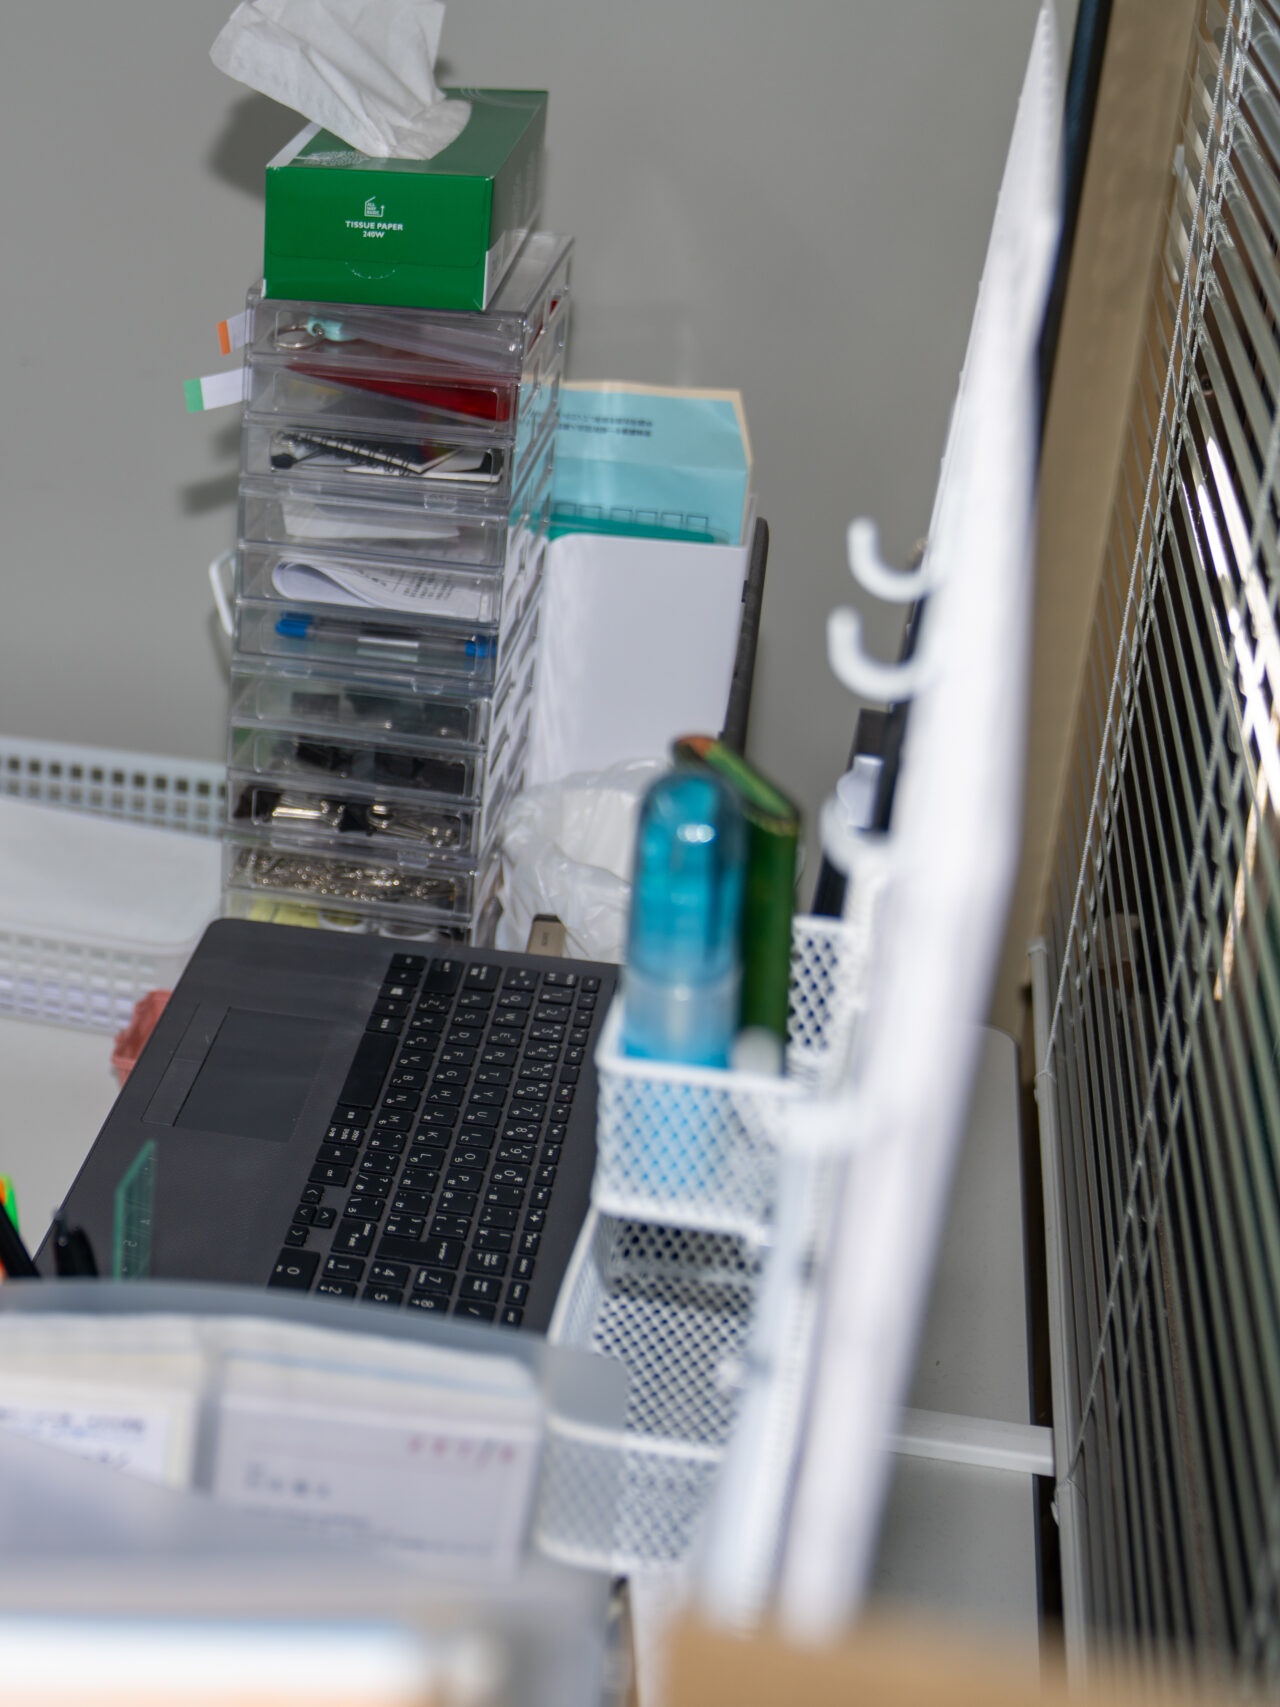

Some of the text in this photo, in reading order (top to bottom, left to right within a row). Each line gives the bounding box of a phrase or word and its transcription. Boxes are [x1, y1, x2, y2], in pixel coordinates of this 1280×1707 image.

[345, 220, 404, 231] TISSUE PAPER
[362, 230, 385, 239] 240W
[287, 1267, 300, 1275] 0
[328, 1286, 342, 1294] 2
[374, 1293, 388, 1301] 5
[420, 1300, 434, 1308] 8
